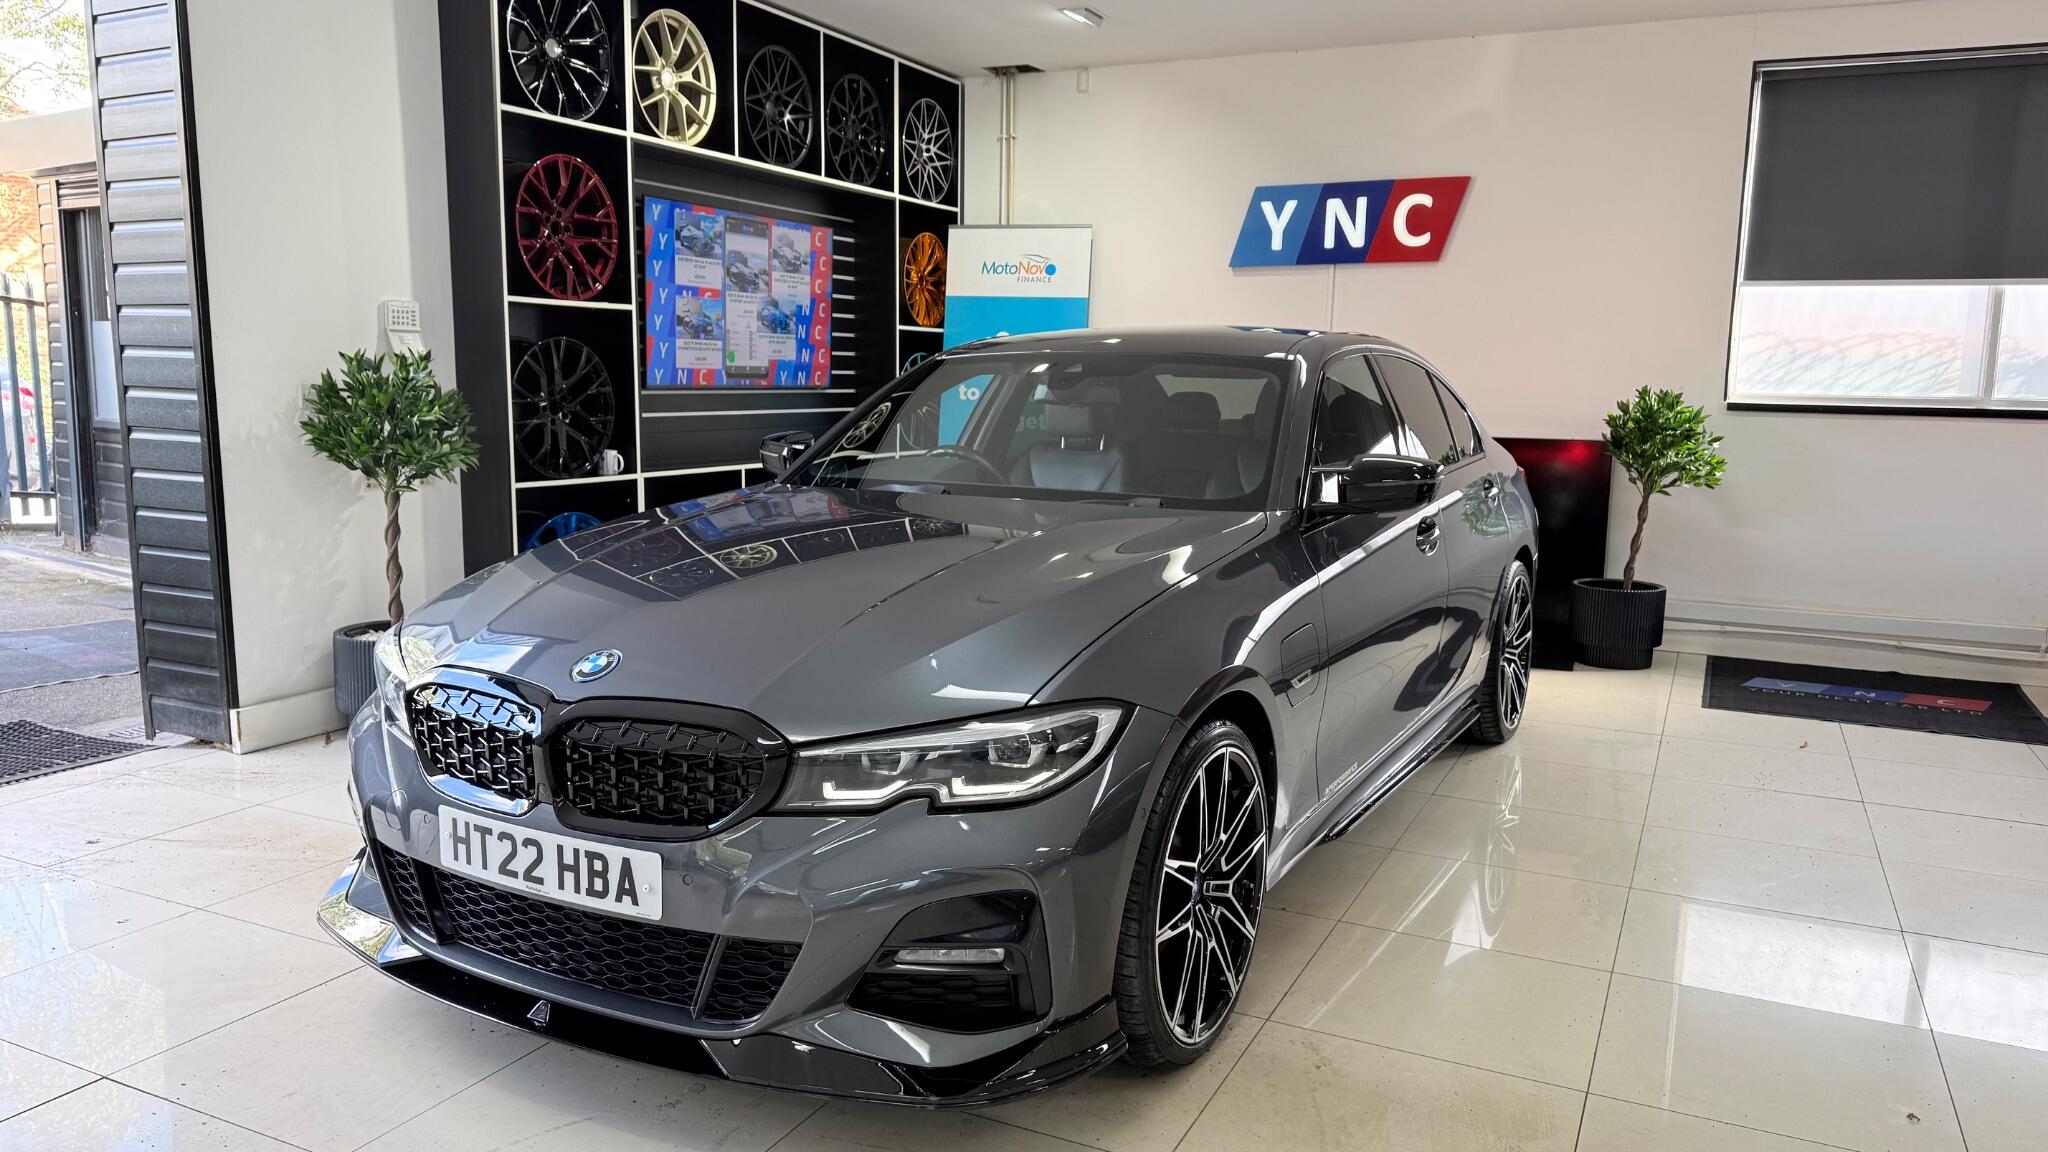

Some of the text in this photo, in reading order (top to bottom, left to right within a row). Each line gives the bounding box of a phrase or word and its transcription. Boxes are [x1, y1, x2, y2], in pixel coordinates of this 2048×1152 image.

[1260, 193, 1433, 251] YNC
[958, 384, 980, 400] to
[451, 817, 640, 907] HT22 HBA
